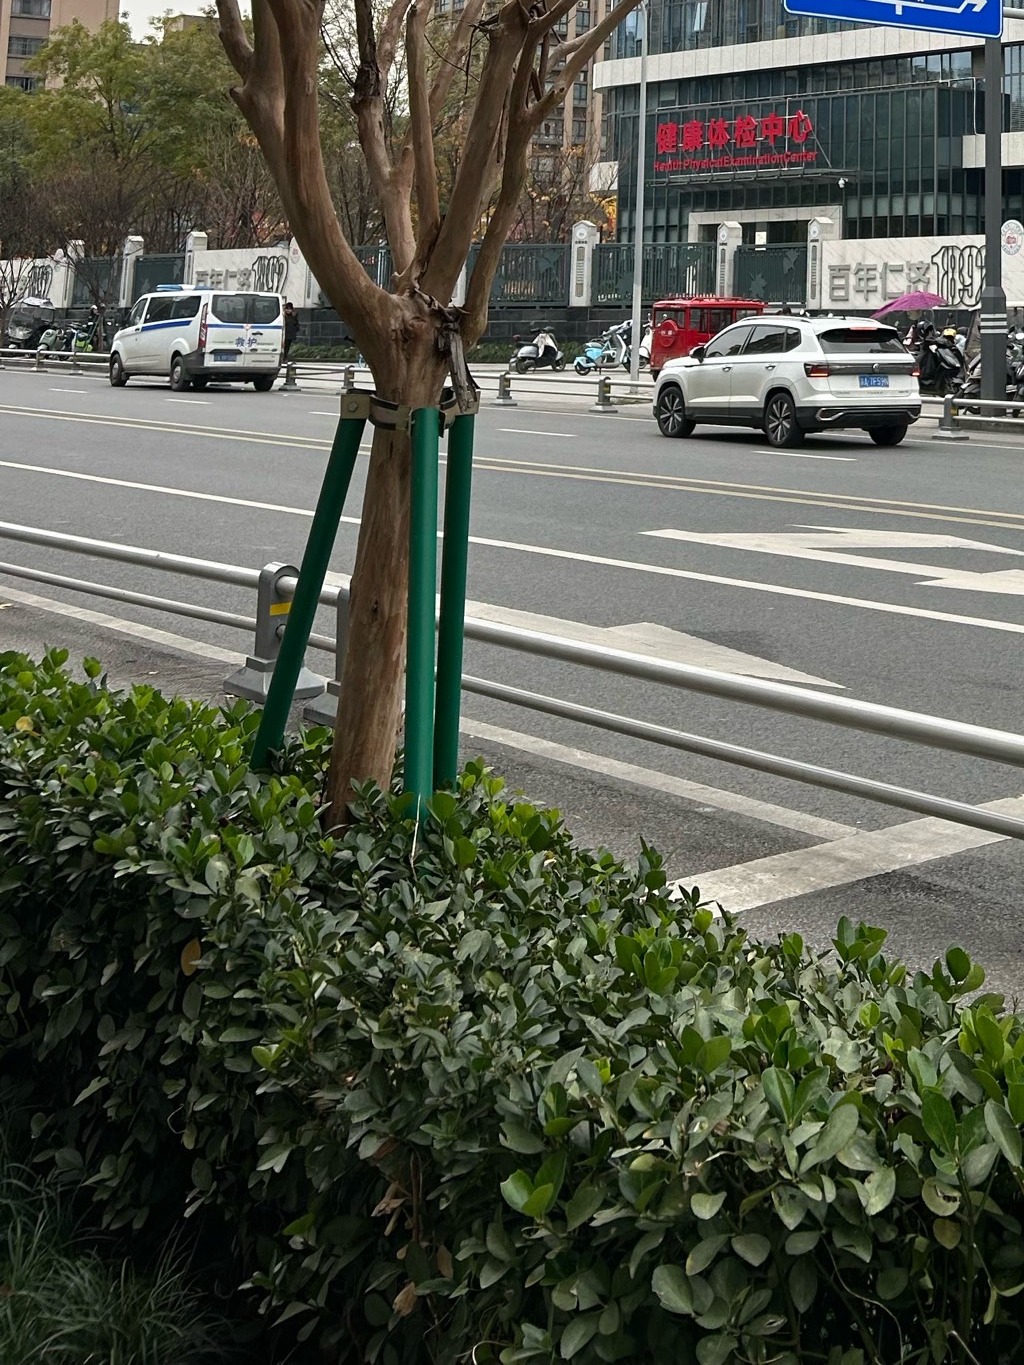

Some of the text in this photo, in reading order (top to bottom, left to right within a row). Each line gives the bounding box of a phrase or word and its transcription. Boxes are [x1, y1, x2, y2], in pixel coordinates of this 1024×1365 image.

[656, 110, 813, 154] 健康体检中心
[654, 150, 818, 172] Health Physical Examination Center
[828, 260, 931, 302] 百年仁济
[235, 336, 257, 347] 救护
